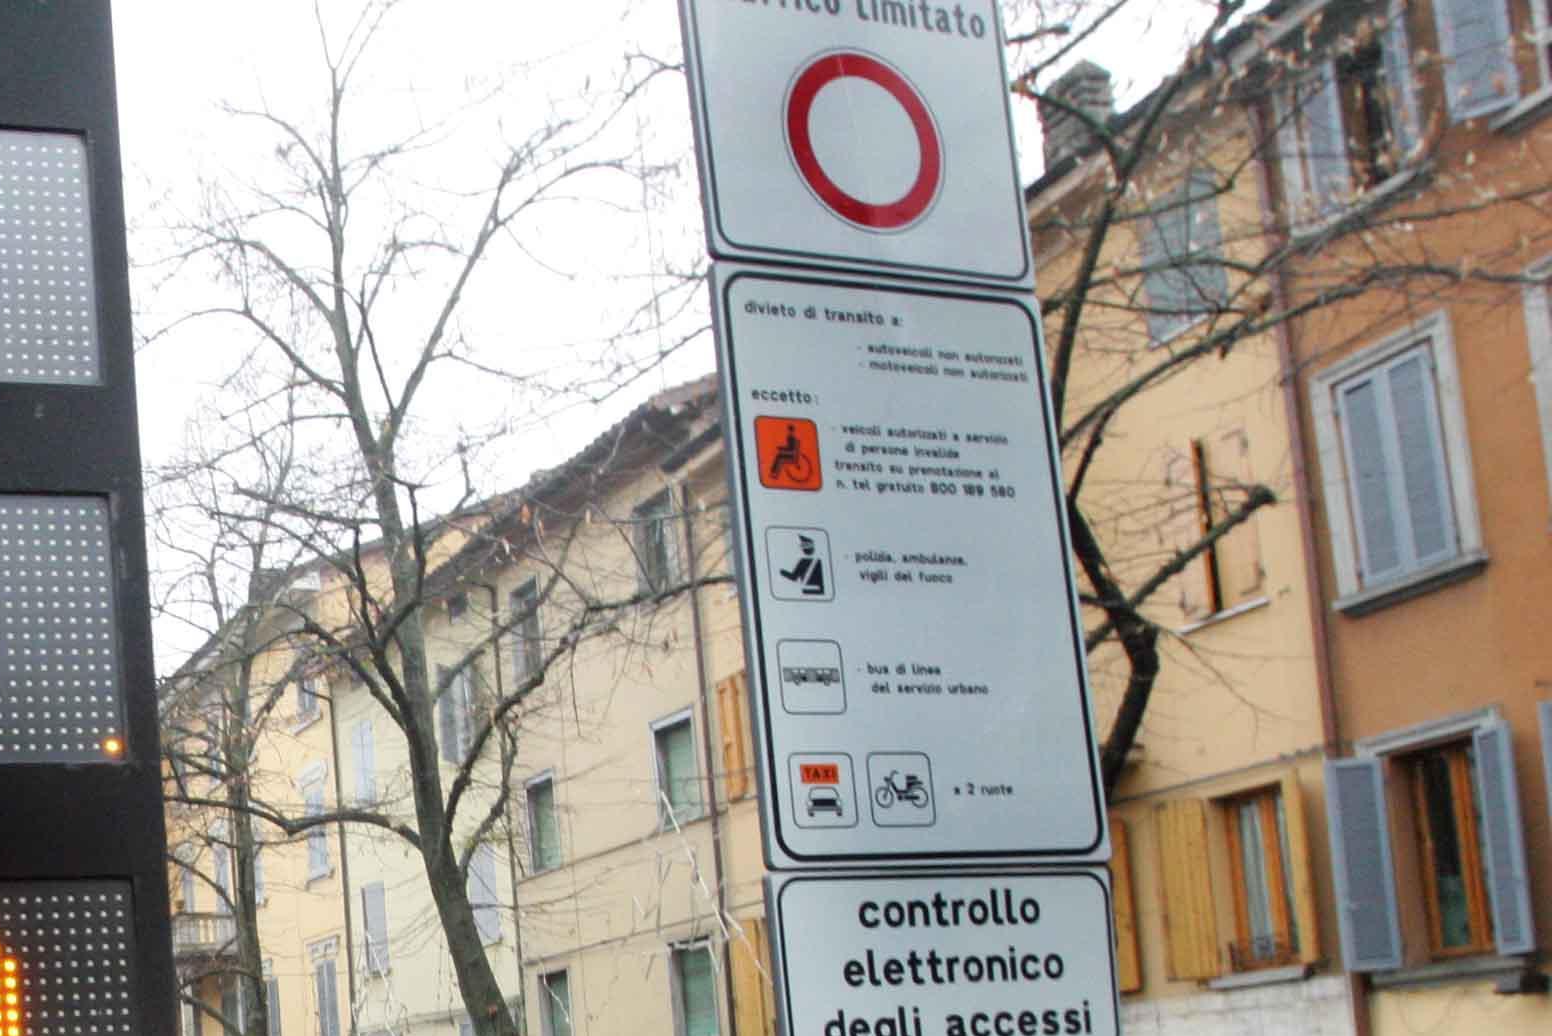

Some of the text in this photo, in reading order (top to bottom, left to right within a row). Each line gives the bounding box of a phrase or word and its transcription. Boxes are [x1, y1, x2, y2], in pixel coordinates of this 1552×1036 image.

[856, 0, 986, 39] limitato
[744, 300, 797, 318] divieto
[804, 306, 817, 320] di
[825, 308, 885, 326] transito
[867, 344, 1023, 366] autoveicoli non autorizzati
[869, 360, 1028, 382] motoveicoli non autorizzati
[841, 424, 881, 436] veicoli
[887, 427, 947, 441] autorizzati
[965, 432, 1009, 445] servizio
[845, 440, 960, 459] di persone invalide
[835, 459, 1000, 481] transito su prenotazione al
[876, 480, 925, 494] gratuito
[930, 481, 958, 496] 800
[859, 569, 953, 584] vigili del fuoco
[866, 662, 941, 675] bus di linea
[872, 681, 989, 695] del servizio urbano
[803, 765, 836, 780] TAXI
[966, 782, 976, 796] 2
[981, 784, 1014, 797] ruote
[858, 888, 1041, 928] controllo
[843, 946, 1064, 988] elettronico
